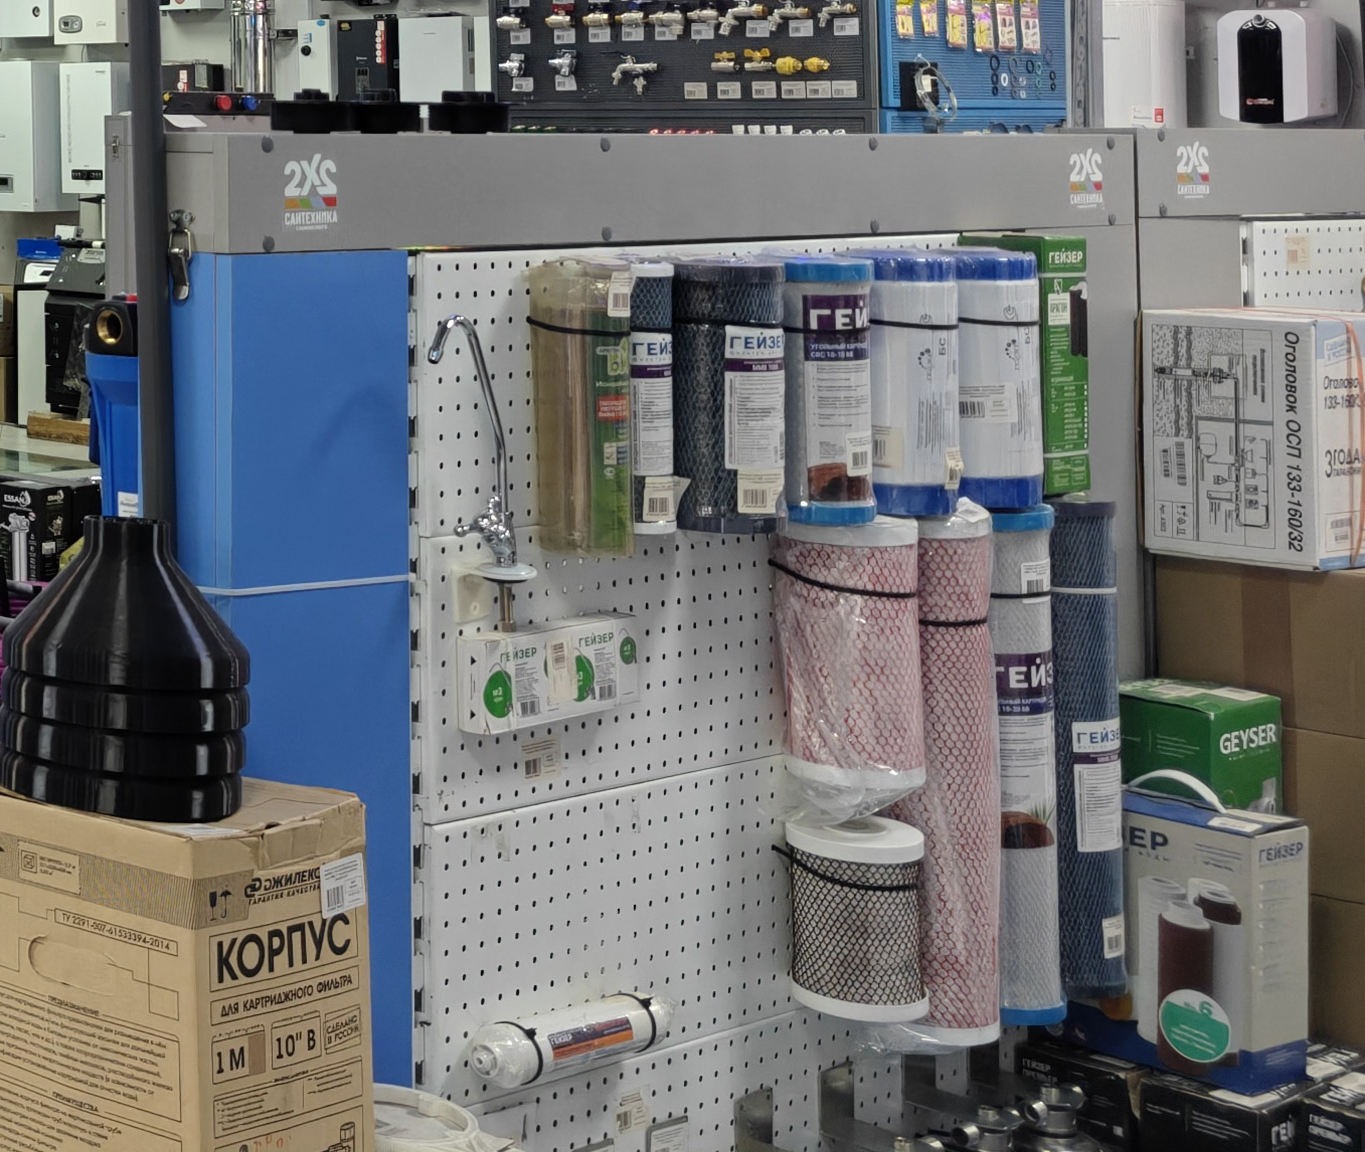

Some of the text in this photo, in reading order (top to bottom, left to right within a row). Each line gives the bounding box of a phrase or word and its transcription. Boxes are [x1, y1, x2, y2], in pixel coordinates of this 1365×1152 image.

[284, 210, 338, 226] САНТЕХНИКА
[1048, 249, 1083, 264] ГЕЙЗЕР
[729, 332, 783, 349] ГЕЙЗЕ
[1283, 331, 1304, 553] Оголовок ОСП 133-160/32
[1332, 449, 1361, 465] ГОДА
[578, 632, 614, 647] ГЕЙЗЕР
[500, 647, 537, 663] ГЕЙЗЕР
[1219, 723, 1278, 755] GEYSER
[1258, 841, 1304, 864] ГЕЙЗЕР
[216, 913, 351, 984] КОРПУС
[220, 974, 353, 1018] ДЛЯ КАРТРИДЖНОГО ФИЛЬТРА
[326, 1014, 358, 1035] СДЕЛАНО
[1022, 1058, 1051, 1071] ГЕЙЗЕР
